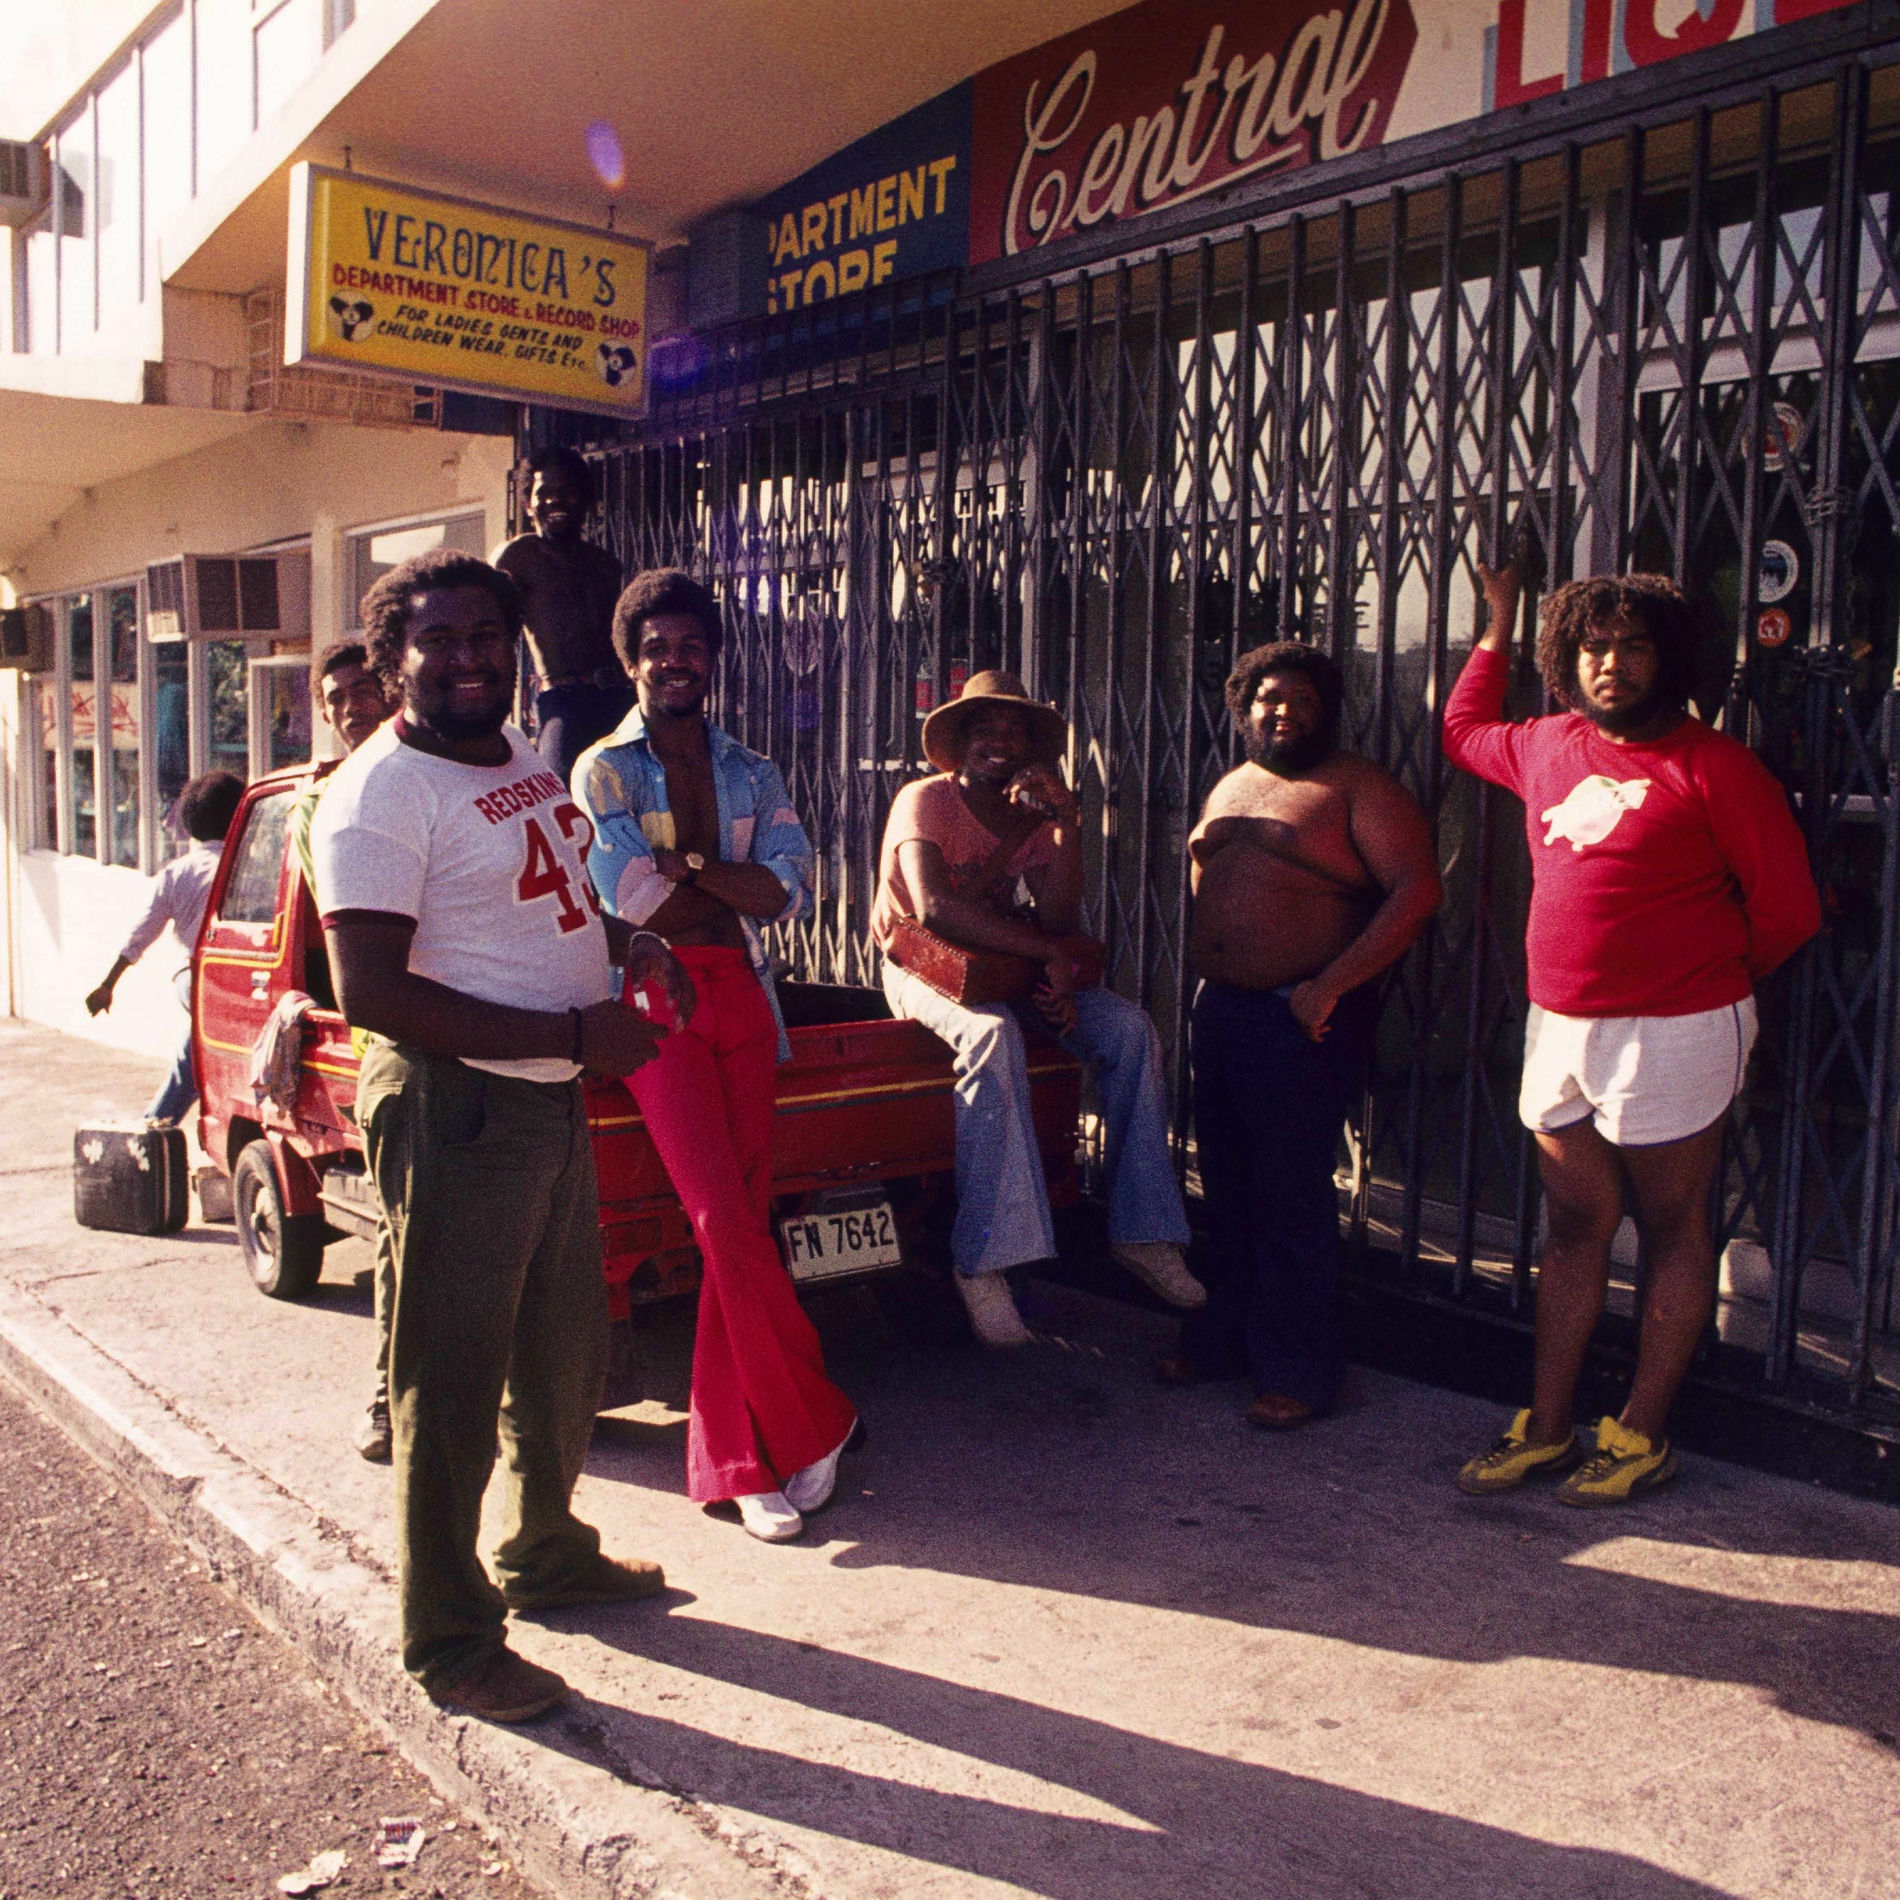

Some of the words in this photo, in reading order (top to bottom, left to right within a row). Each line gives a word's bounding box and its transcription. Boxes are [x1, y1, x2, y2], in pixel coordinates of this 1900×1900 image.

[1005, 0, 1389, 256] Central
[363, 205, 617, 308] VERONICA'S
[332, 262, 461, 306] DEPARTMENT
[464, 290, 521, 320] STORE
[536, 302, 597, 332] RECORD
[599, 314, 641, 340] SHOP
[395, 304, 429, 322] FOR
[434, 312, 493, 336] LADIES
[500, 323, 550, 346] GENTS
[552, 333, 584, 351] AND
[377, 319, 454, 346] CHILDREN
[515, 344, 557, 365] GIFTS
[788, 1222, 824, 1262] FN
[828, 1210, 895, 1255] 7642
